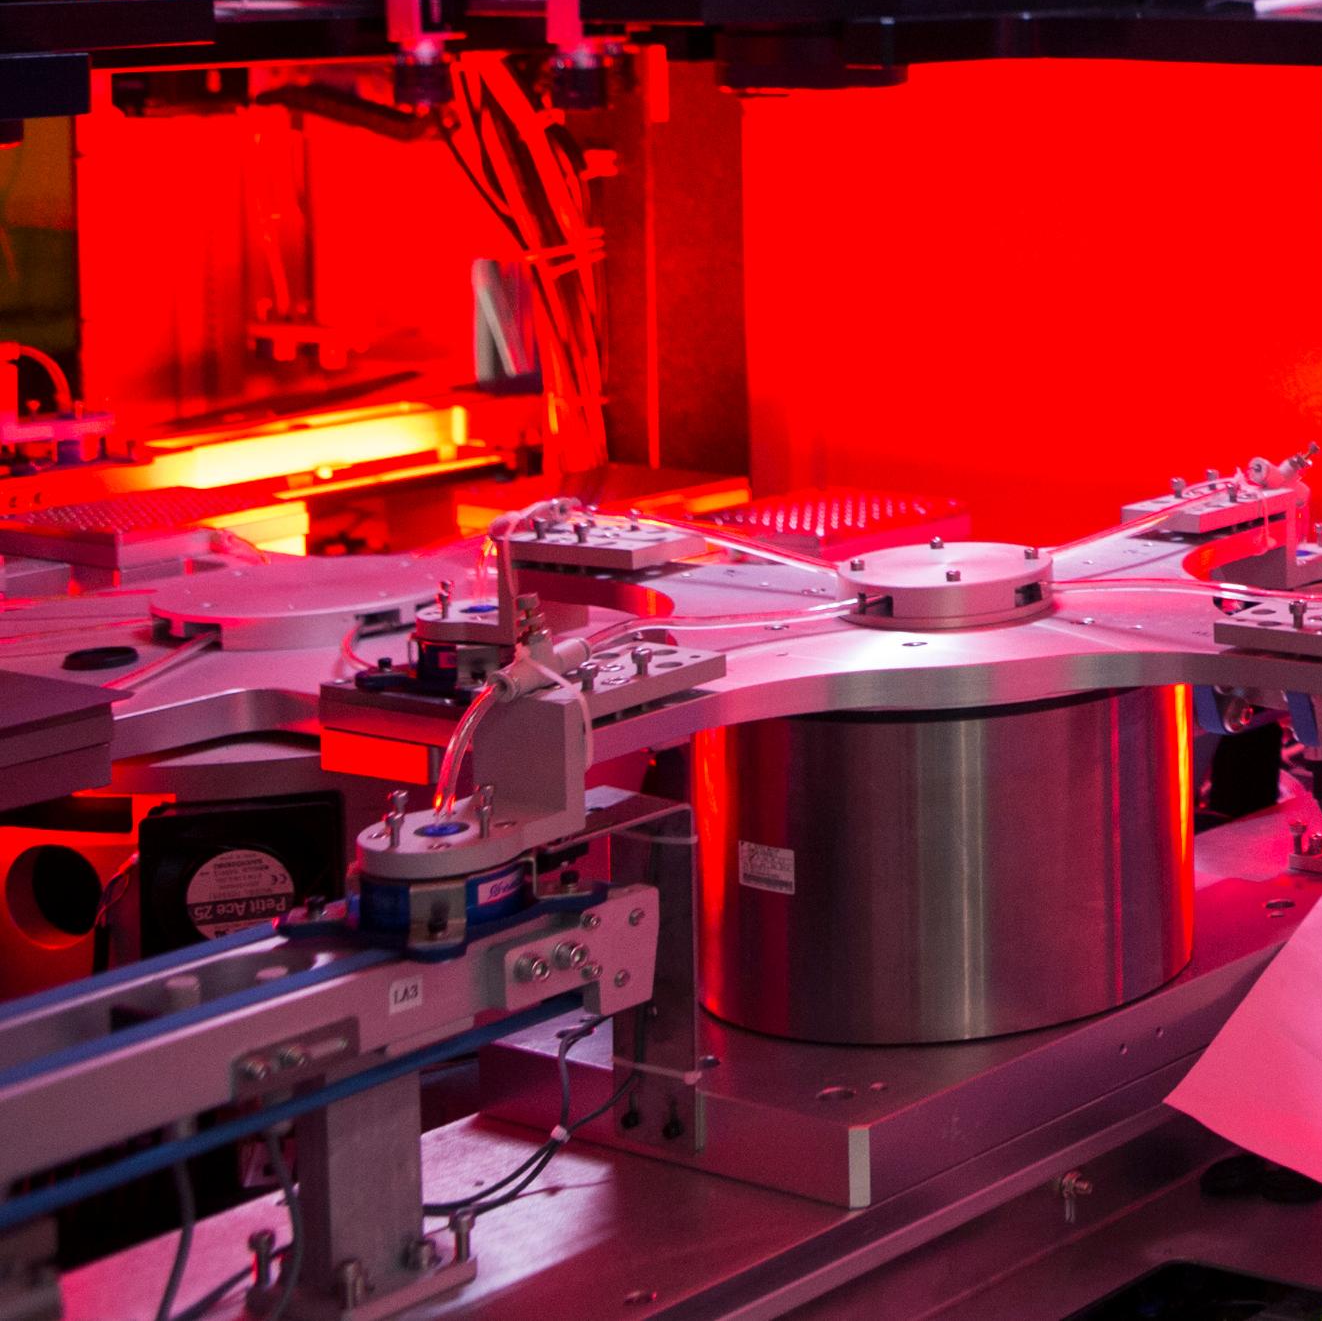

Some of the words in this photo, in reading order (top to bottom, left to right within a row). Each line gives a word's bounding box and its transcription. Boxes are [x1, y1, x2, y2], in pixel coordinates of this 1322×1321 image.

[193, 904, 213, 919] 25
[216, 901, 247, 916] Ace
[249, 896, 286, 912] Petit
